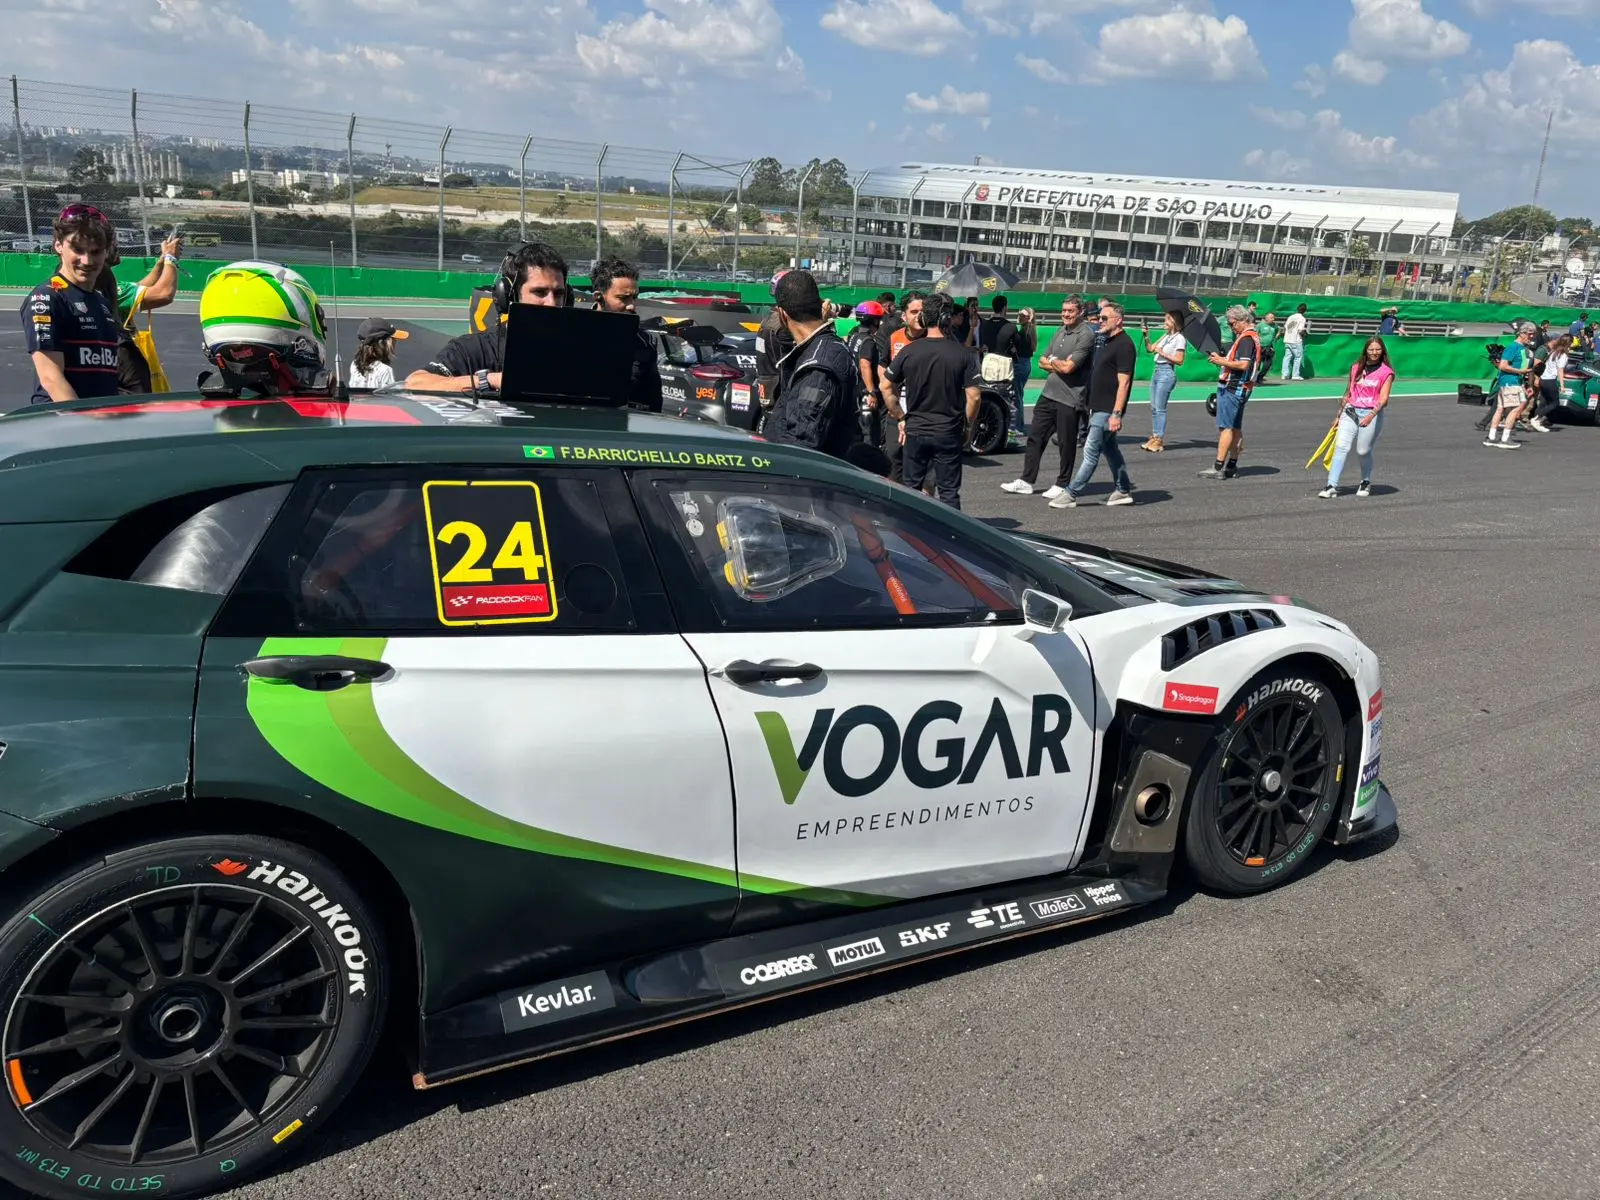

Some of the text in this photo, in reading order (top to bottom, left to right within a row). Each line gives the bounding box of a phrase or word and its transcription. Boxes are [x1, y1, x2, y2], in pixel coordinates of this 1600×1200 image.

[998, 186, 1272, 220] PREFEITURA DE SÃO PAULO
[695, 387, 717, 400] yes!
[560, 446, 771, 468] F.BARRICHELLO BARTZ O+
[436, 520, 545, 583] 24
[1178, 692, 1215, 705] Snapdragon
[754, 693, 1072, 805] VOGAR
[796, 796, 1034, 841] EMPREENDIMENTOS
[146, 866, 181, 885] TD
[1083, 882, 1116, 898] Hipper
[1092, 893, 1122, 906] Freios
[992, 902, 1023, 923] TE
[1037, 897, 1078, 916] MoTeC
[247, 859, 369, 998] Hankook
[898, 922, 951, 948] SKF
[834, 941, 881, 964] MOTUL
[38, 1158, 71, 1179] ET3
[77, 1174, 102, 1190] TD
